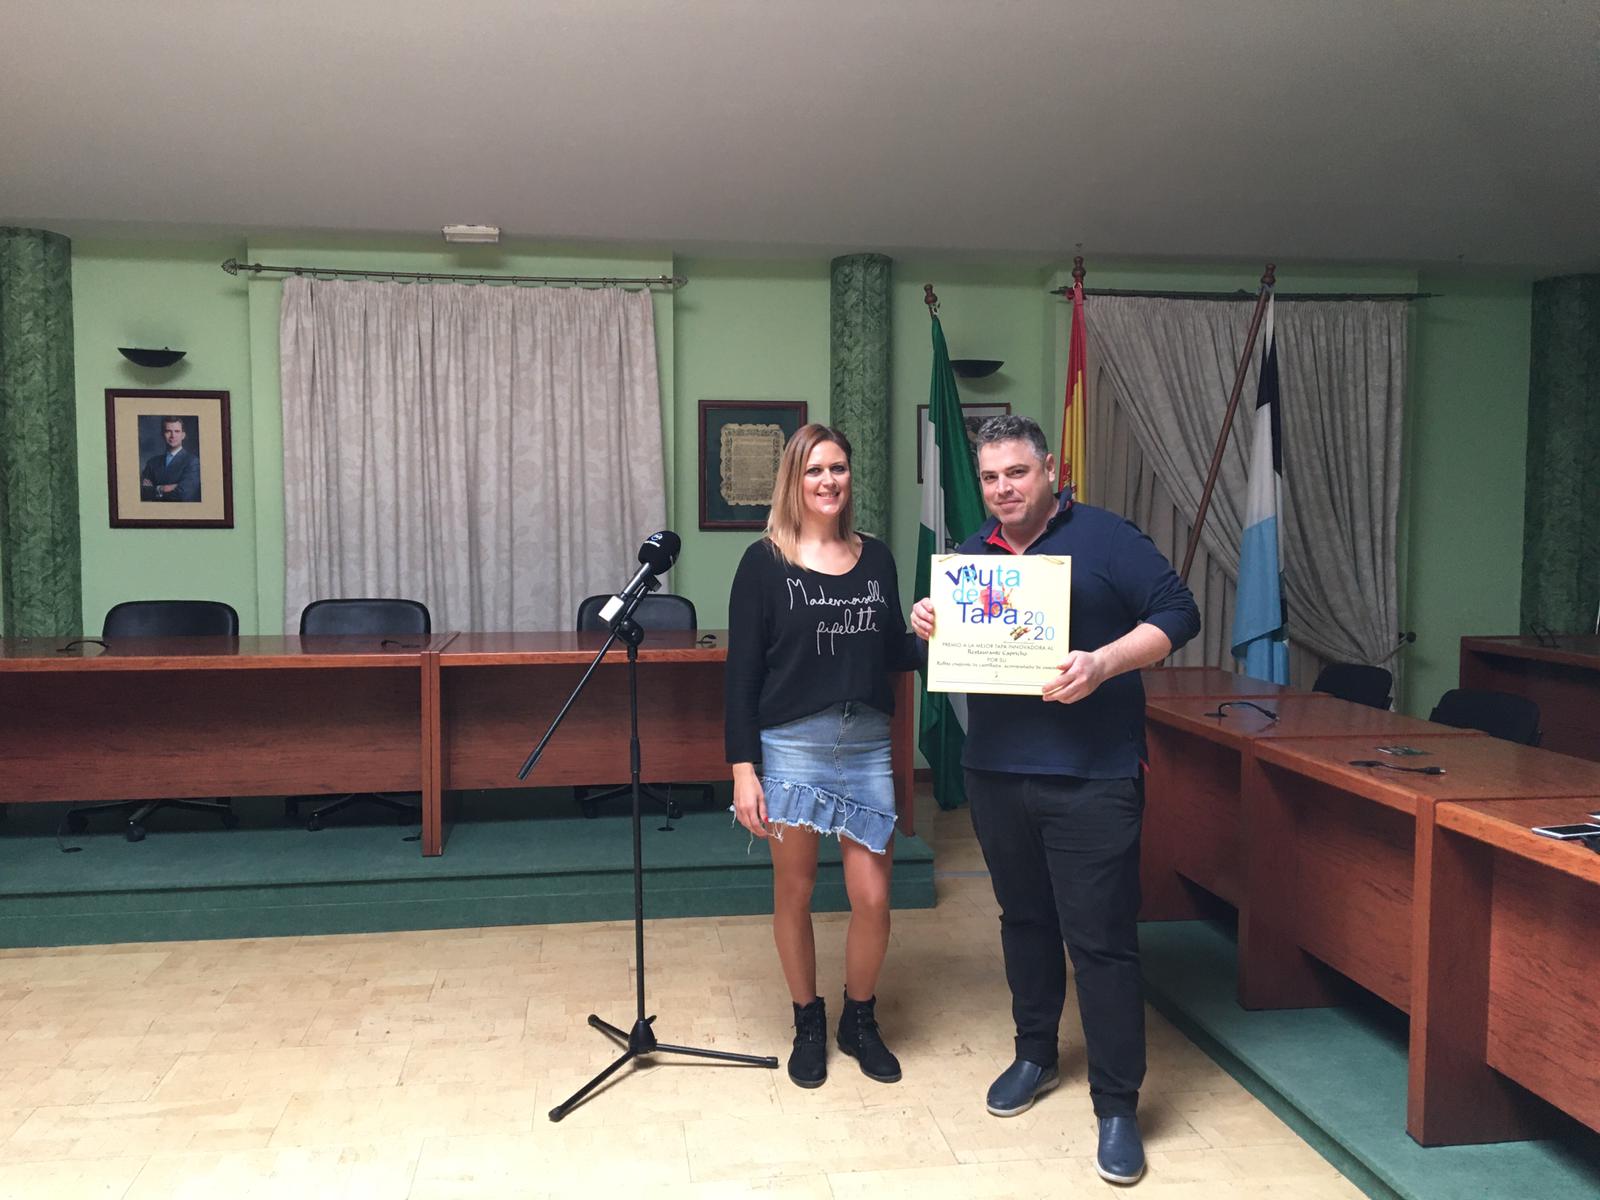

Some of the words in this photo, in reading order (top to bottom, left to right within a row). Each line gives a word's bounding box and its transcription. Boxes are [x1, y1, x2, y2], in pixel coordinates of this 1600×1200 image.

[956, 600, 1018, 625] Tapa
[1023, 610, 1045, 626] 20
[1033, 625, 1055, 641] 20
